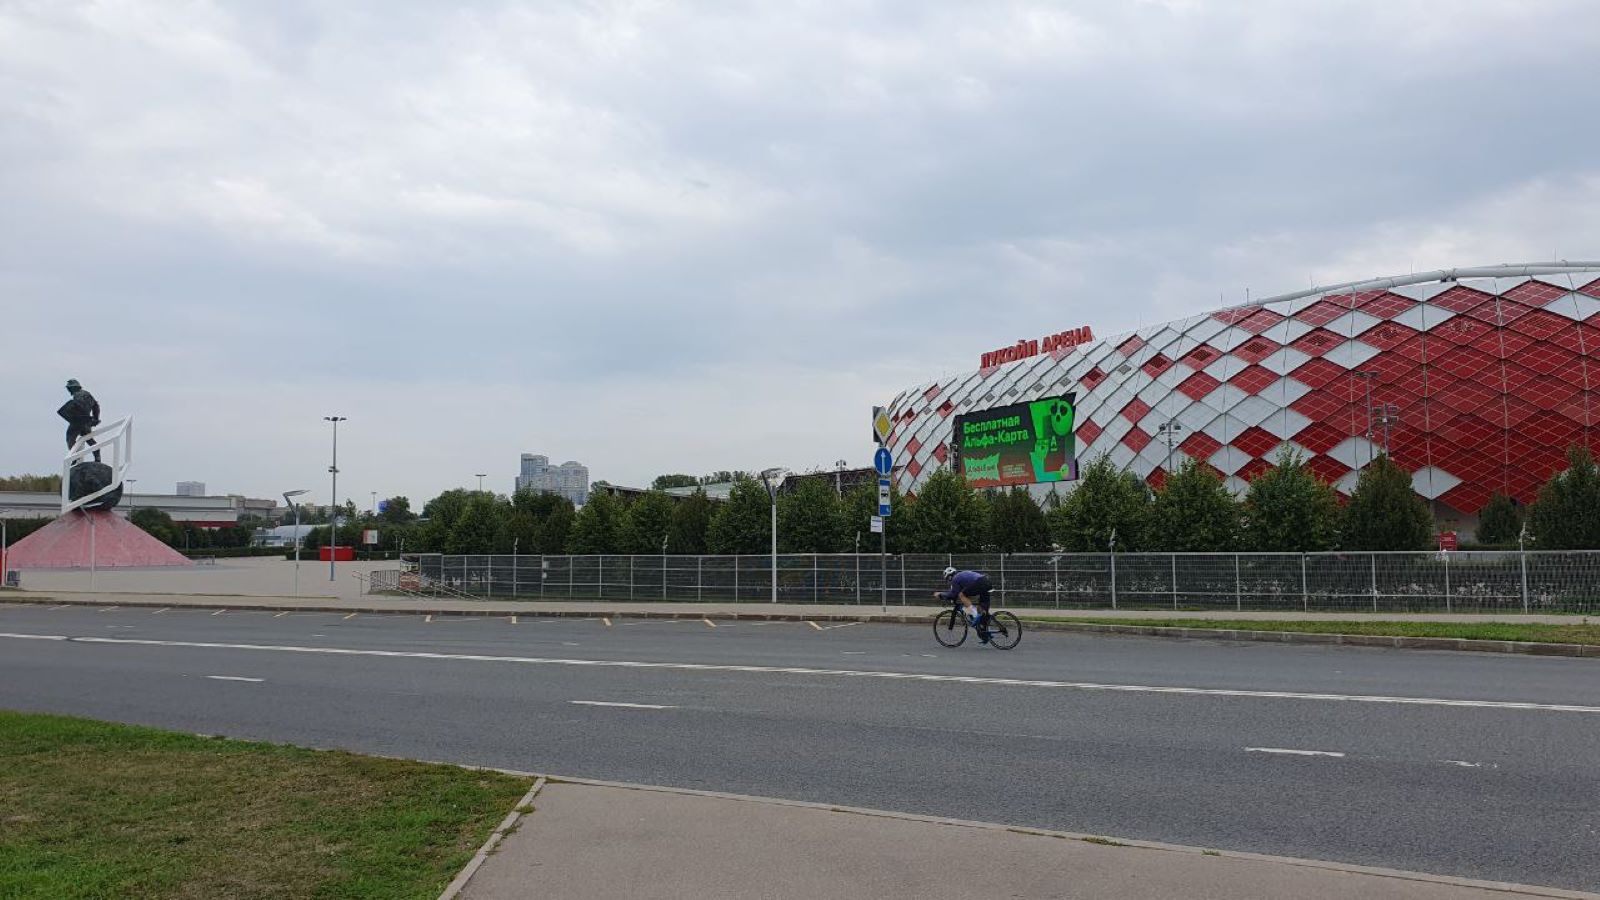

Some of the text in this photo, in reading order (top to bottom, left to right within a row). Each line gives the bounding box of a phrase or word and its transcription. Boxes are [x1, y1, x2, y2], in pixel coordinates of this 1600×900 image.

[981, 325, 1093, 367] ЛУКОЙЛ АРЕНА
[964, 416, 1020, 434] Бесплатная
[964, 430, 1029, 448] Альфа-Карта
